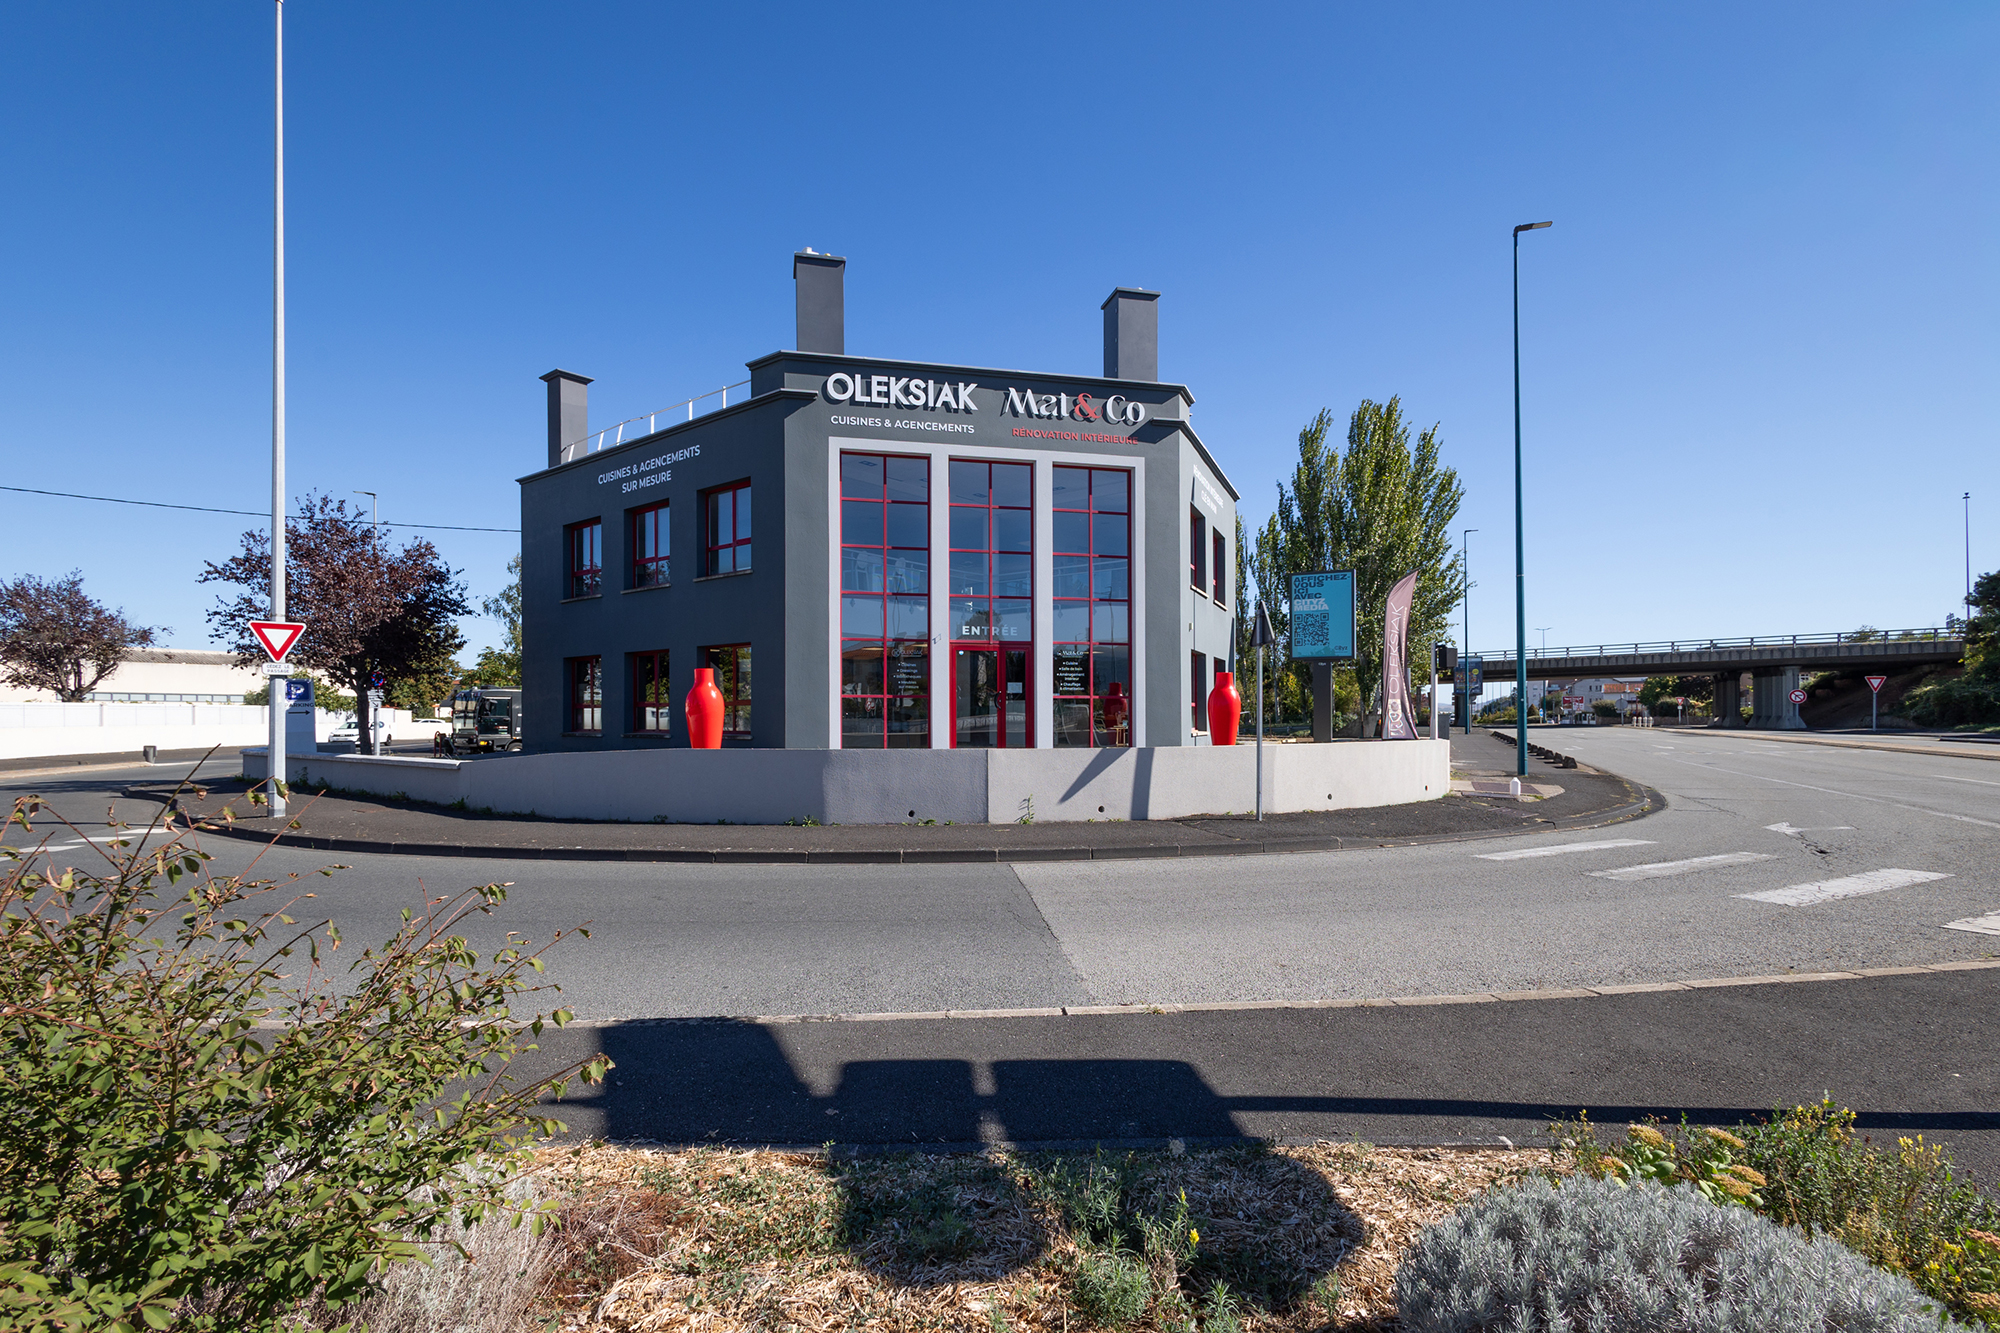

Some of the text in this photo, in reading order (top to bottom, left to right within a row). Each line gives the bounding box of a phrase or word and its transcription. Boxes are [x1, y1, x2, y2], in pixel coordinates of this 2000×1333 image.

[827, 373, 978, 410] OLEKSIAK
[831, 415, 975, 433] CUISINES & AGENCEMENTS
[1012, 426, 1138, 445] RÉNOVATION INTÉRIEURE
[598, 444, 701, 485] CUISINES & AGENCEMENTS
[621, 470, 672, 494] SUR MESURE
[1293, 573, 1350, 583] AFFICHEZ-
[1293, 592, 1322, 600] AVEC
[1293, 598, 1326, 606] CITYZ
[962, 624, 1018, 636] ENTRÉE
